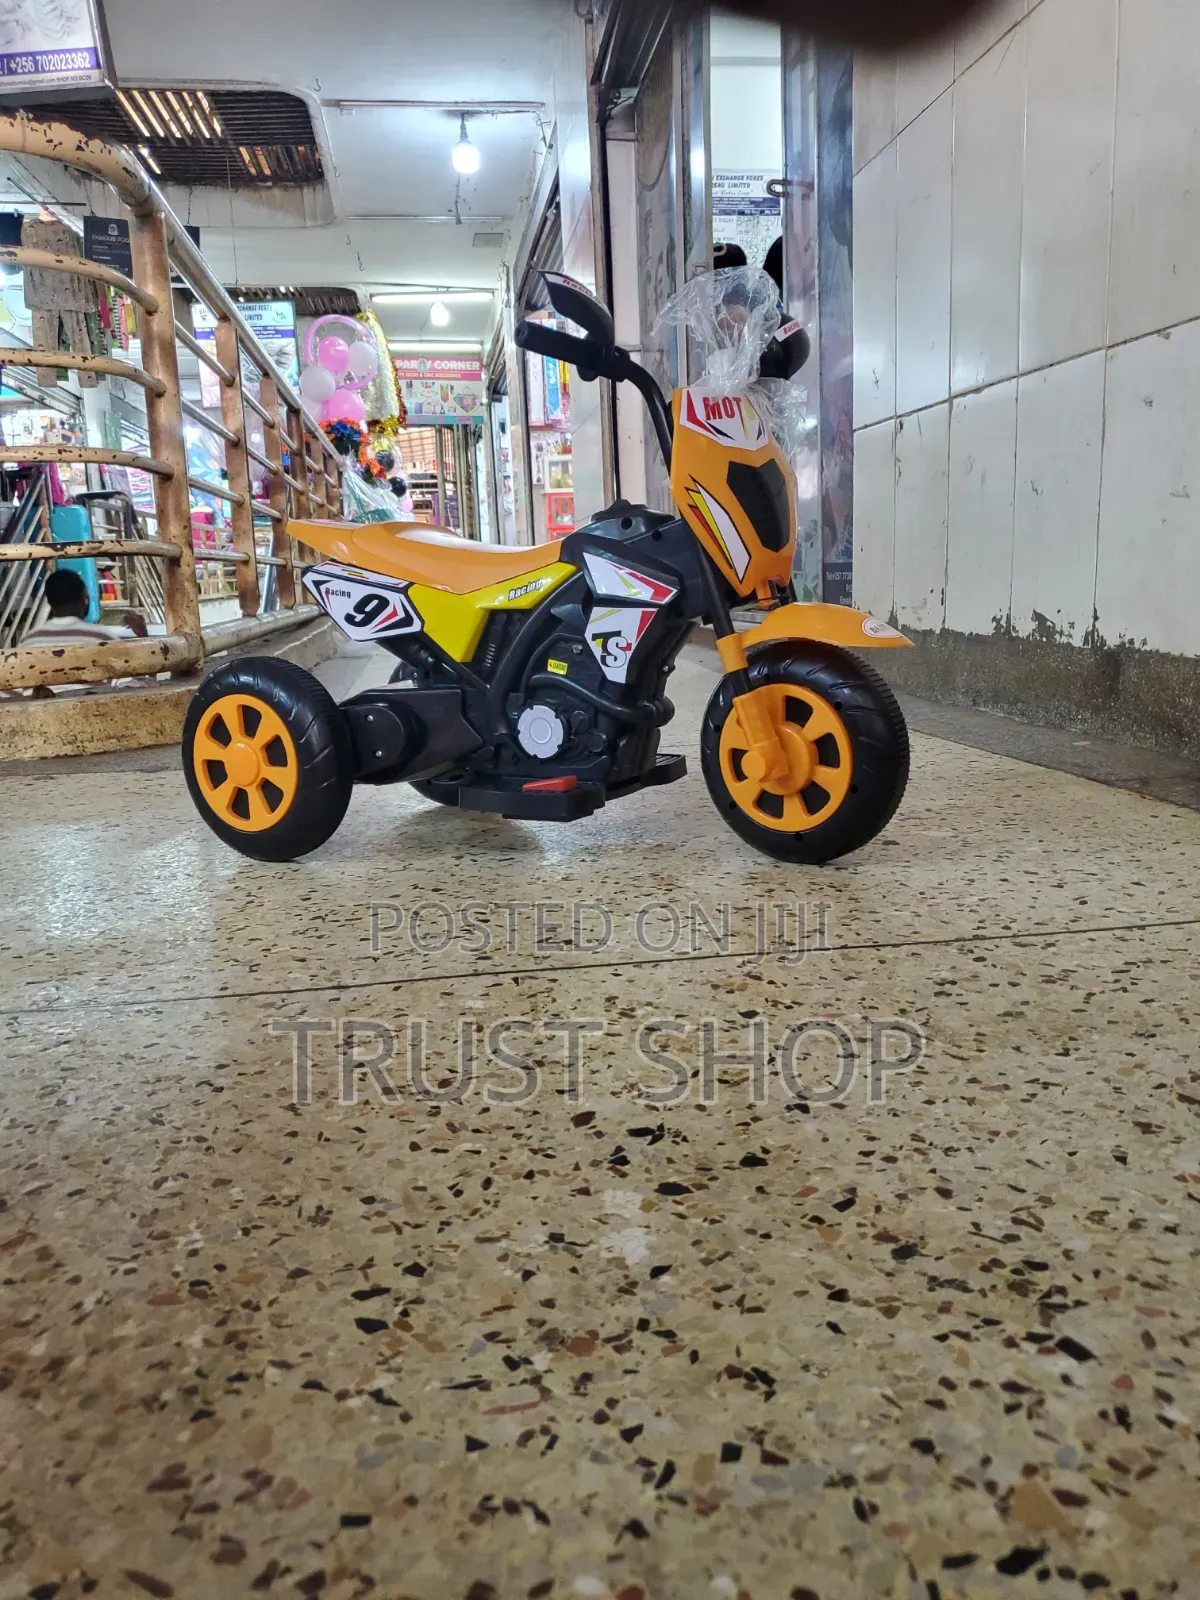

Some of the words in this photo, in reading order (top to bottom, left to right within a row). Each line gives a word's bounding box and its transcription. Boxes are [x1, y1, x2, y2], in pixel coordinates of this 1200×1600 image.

[9, 56, 35, 73] +256
[36, 52, 91, 72] 702023362
[395, 359, 432, 369] PARY
[434, 360, 480, 370] CORNER
[325, 587, 351, 598] Racing
[508, 578, 543, 601] Racing
[344, 593, 390, 627] 9
